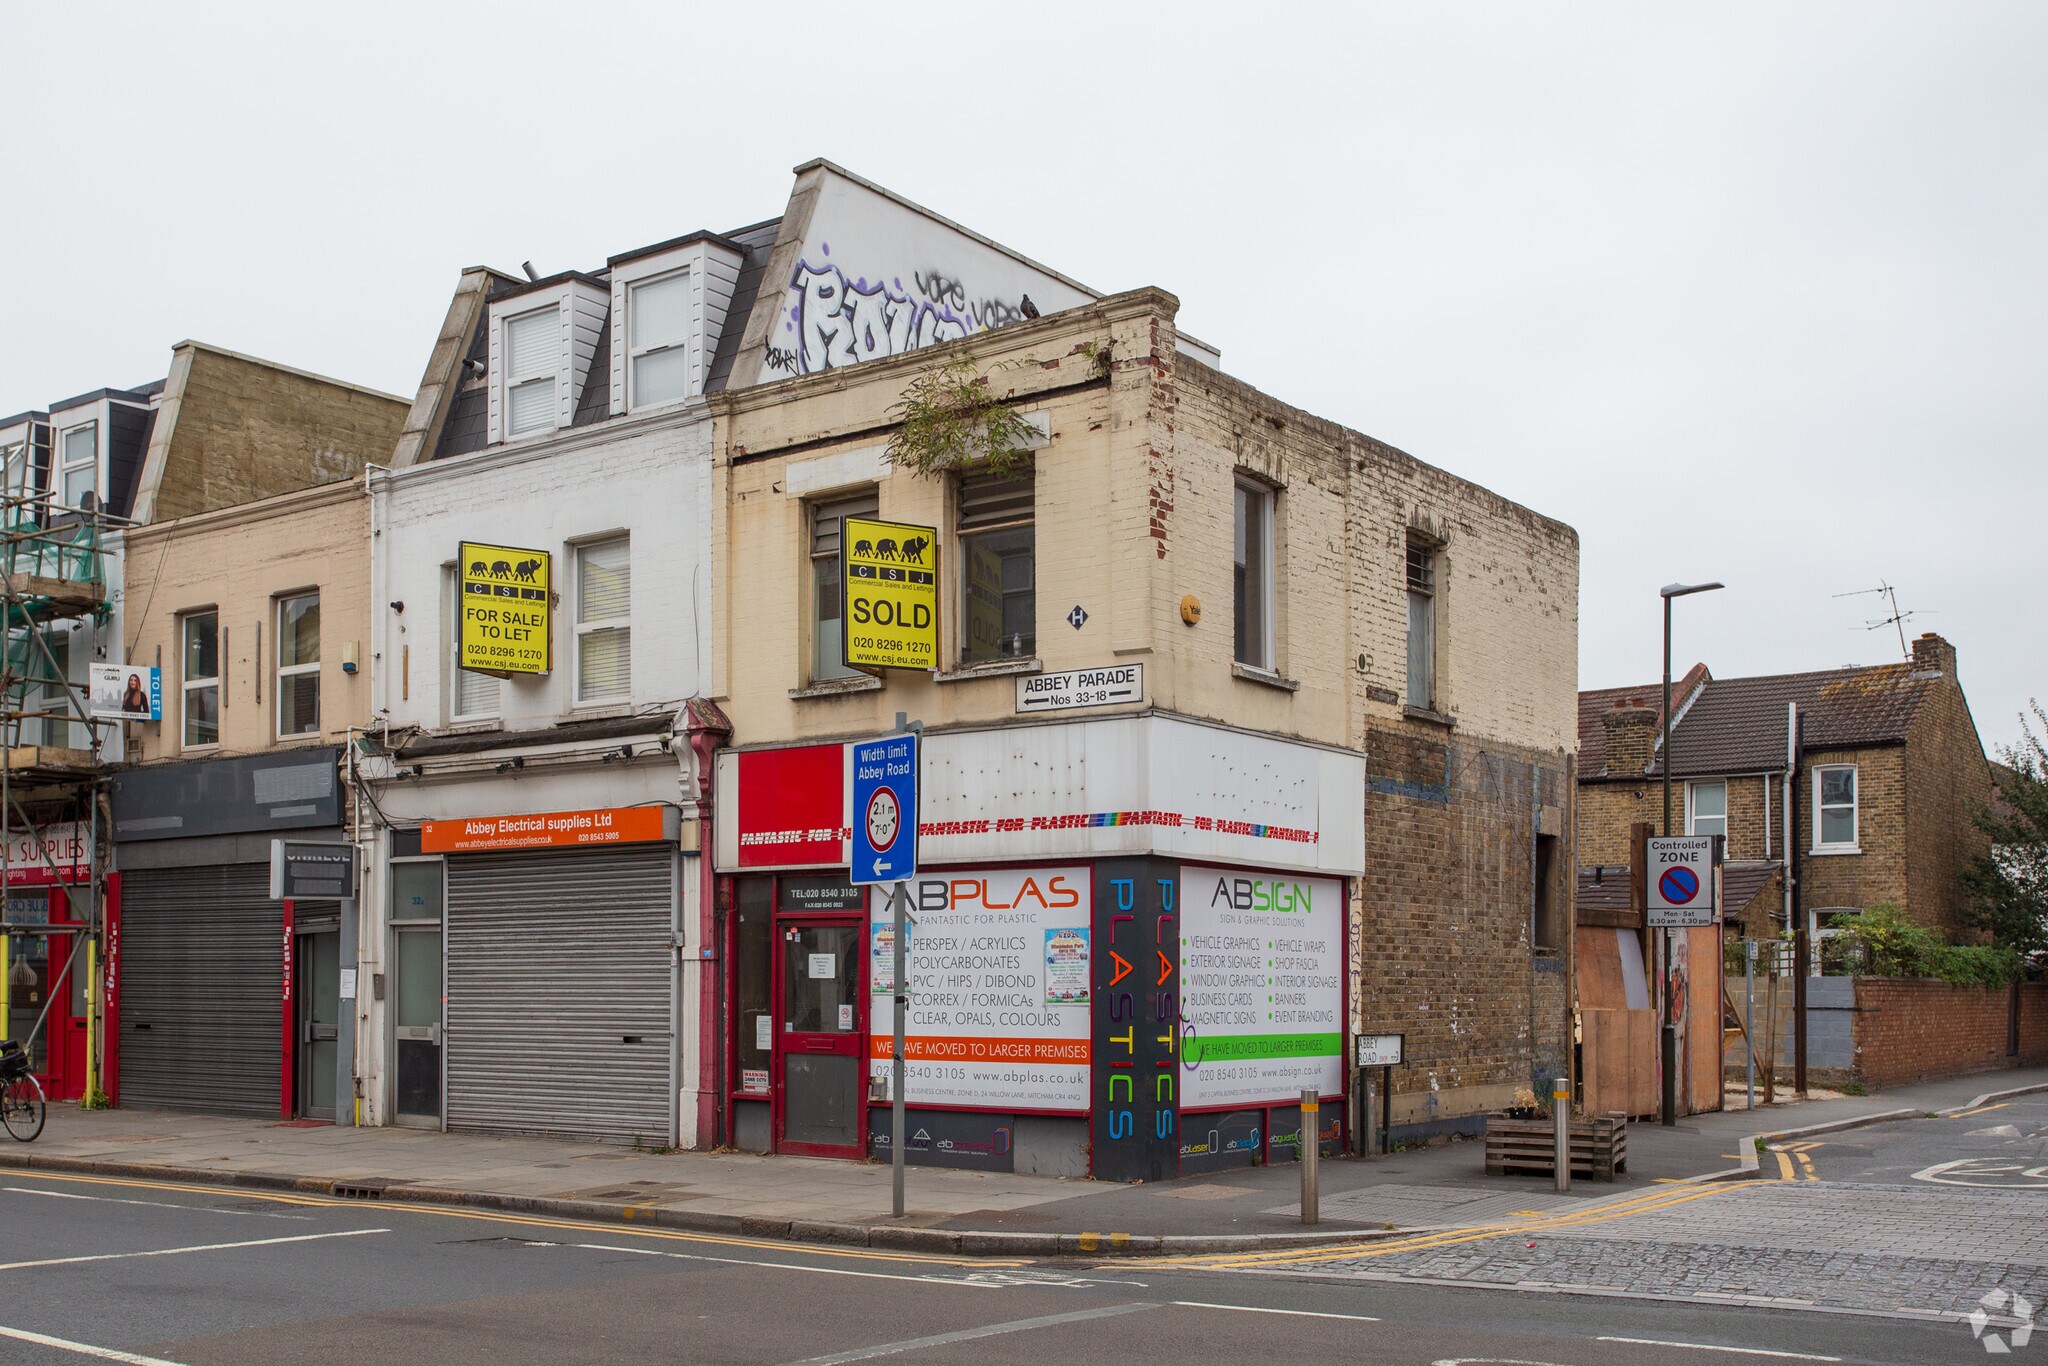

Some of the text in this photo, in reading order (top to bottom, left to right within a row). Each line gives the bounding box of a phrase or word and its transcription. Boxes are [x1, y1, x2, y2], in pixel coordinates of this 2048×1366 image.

[849, 577, 934, 593] Commercial Sales and Lettings
[464, 594, 497, 602] Commercial
[467, 608, 544, 627] FOR SALE/
[853, 597, 931, 629] SOLD
[480, 625, 531, 641] TO LET
[468, 644, 542, 659] 020 8296 1270
[854, 636, 931, 653] 020 8296 1270
[470, 658, 540, 670] www.csj.eu.com
[857, 652, 929, 665] www.csj.eu.com
[1025, 668, 1135, 694] ABBEY PARADE
[152, 675, 160, 712] TO LET
[1050, 690, 1107, 706] Nos 33-18
[860, 744, 908, 763] Width limit
[858, 761, 910, 781] Abbey Road
[873, 802, 894, 815] 2.1 m
[425, 825, 433, 833] 32
[465, 812, 612, 836] Abbey Electrical supplies Ltd
[919, 820, 990, 836] FANTASTIC
[996, 818, 1024, 832] FOR
[1031, 814, 1089, 830] PLASTIC
[1124, 811, 1182, 827] FANTASTIC
[1194, 816, 1212, 831] FOR
[1216, 819, 1251, 836] PLASTIC
[1268, 826, 1310, 843] FANTASTIC
[590, 832, 604, 841] 8543
[605, 831, 619, 840] 5005
[740, 830, 802, 845] FANTASTIC
[807, 828, 832, 842] FOR
[21, 837, 84, 862] SUPPLIES
[1652, 840, 1708, 850] Controlled
[1659, 852, 1699, 862] ZONE
[820, 888, 838, 898] 8540
[840, 888, 858, 898] 3105
[884, 876, 1079, 912] ABPLAS
[1211, 876, 1312, 914] ABSIGN
[920, 914, 1037, 925] FANTASTIC FOR PLASTIC
[1220, 914, 1305, 928] SIGN & GRAPHIC SOLUTIONS
[913, 937, 1026, 951] PERSPEX ACRYLICS
[1190, 935, 1260, 951] VEHICLE GRAPHICS
[1274, 939, 1326, 954] VEHICLE WRAPS
[913, 956, 1020, 970] POLYCARBONATES
[1191, 954, 1261, 969] EXTERIOR SIGNAGE
[1274, 957, 1319, 971] SHOP FASCIA
[913, 975, 1036, 988] PVC HIPS DIBOND
[1190, 974, 1265, 988] WINDOW GRAPHICS
[1274, 975, 1338, 989] INTERIOR SIGNAGE
[913, 993, 1033, 1007] CORREX FORMICAs
[1190, 992, 1253, 1006] BUSINESS CARDS
[1274, 993, 1307, 1006] BANNERS
[1109, 878, 1134, 1140] PLASTICS
[1156, 878, 1173, 1140] PLASTICS
[1274, 1010, 1333, 1023] EVENT BRANDING
[913, 1012, 1061, 1027] CLEAR, OPALS, COLOURS
[1190, 1011, 1256, 1025] MAGNETIC SIGNS
[876, 1041, 1088, 1059] WE AVE MOVED TO LARGER PREMISES
[1199, 1039, 1323, 1055] WE HAVE MOVED TO LARGER PREMISES
[1359, 1037, 1378, 1049] ABBEY
[1359, 1052, 1377, 1063] ROAD
[936, 1067, 965, 1080] 3105
[973, 1070, 1084, 1085] www.abplas.co.uk
[1200, 1066, 1322, 1081] 020 8540 3105 www.absign.co.uk
[911, 1087, 934, 1095] BUSINESS
[957, 1089, 972, 1097] ZONE
